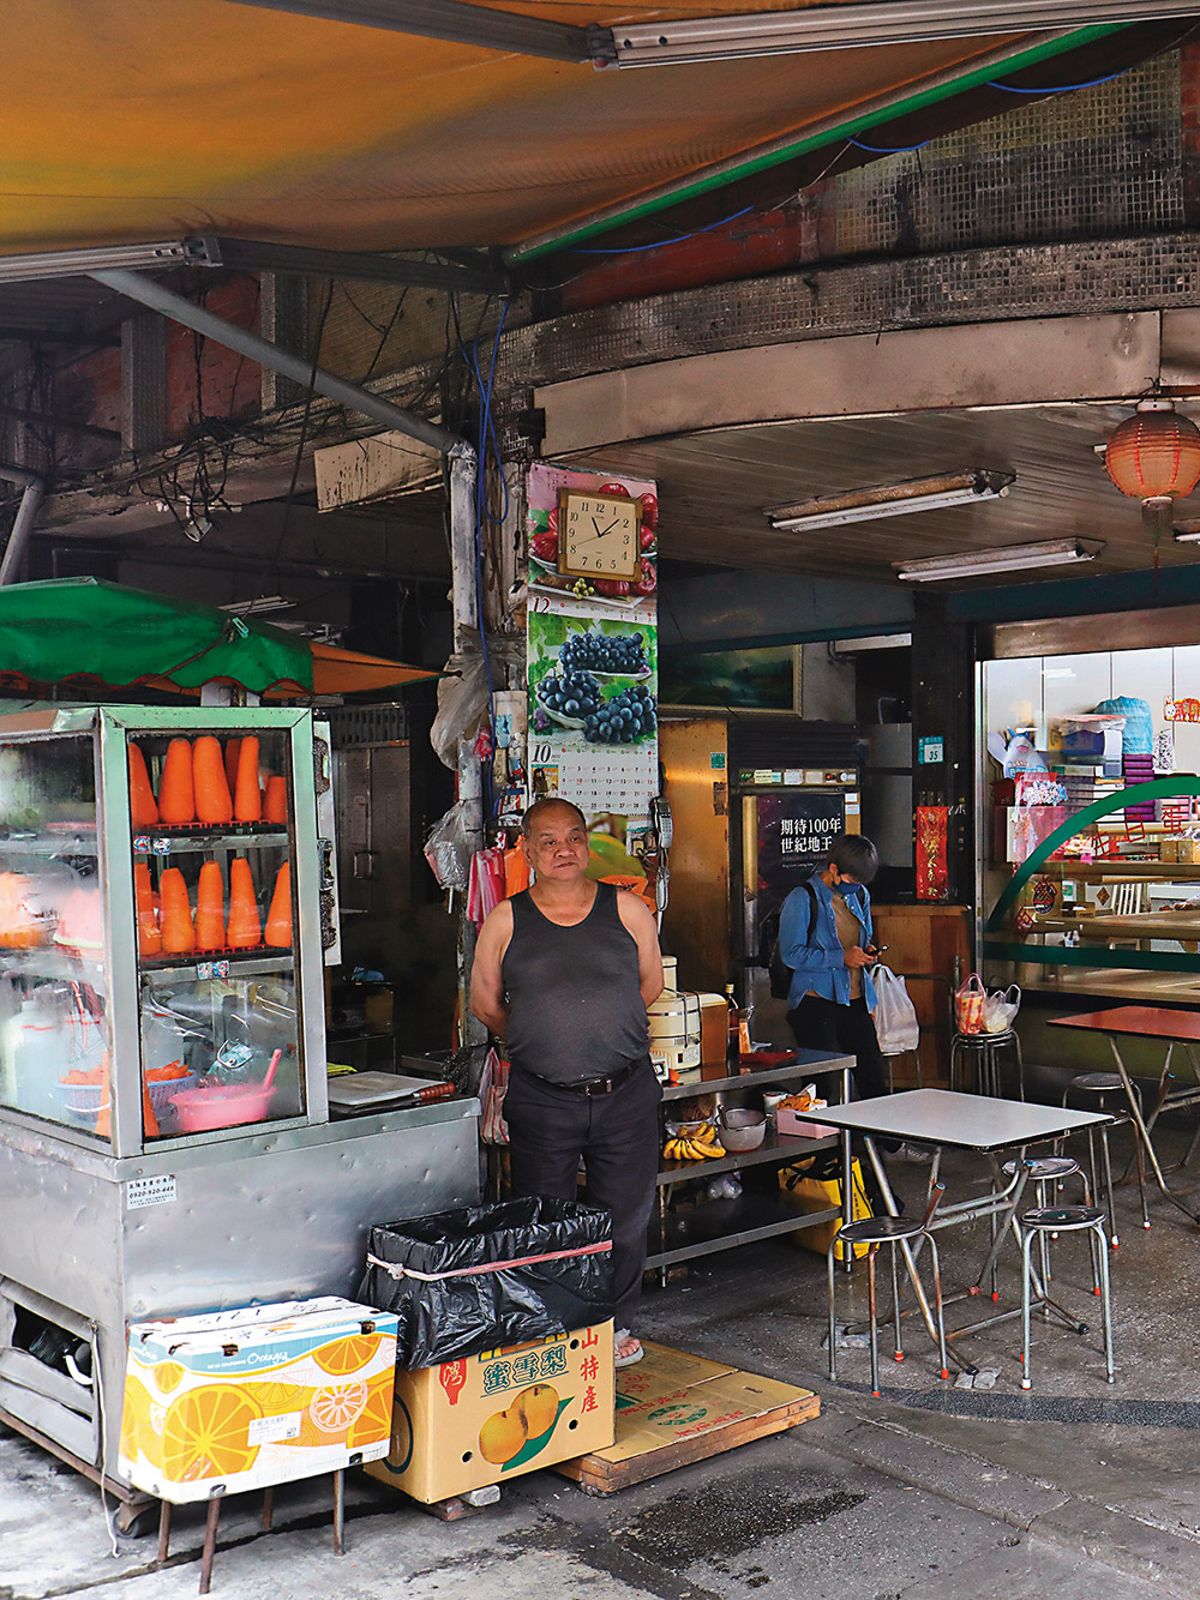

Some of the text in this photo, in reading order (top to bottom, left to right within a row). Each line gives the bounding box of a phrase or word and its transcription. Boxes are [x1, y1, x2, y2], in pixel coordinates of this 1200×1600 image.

[581, 502, 589, 512] 11
[595, 503, 605, 513] 12
[570, 511, 629, 529] 10 2
[568, 528, 630, 545] 9 3
[570, 545, 628, 561] 8 4
[582, 556, 616, 569] 7 6 5
[533, 596, 550, 614] 12
[532, 744, 552, 764] 10
[780, 817, 842, 836] 期待100年
[780, 835, 833, 854] 世紀地王
[483, 1344, 568, 1394] 蜜雪梨
[580, 1327, 600, 1414] 山特產
